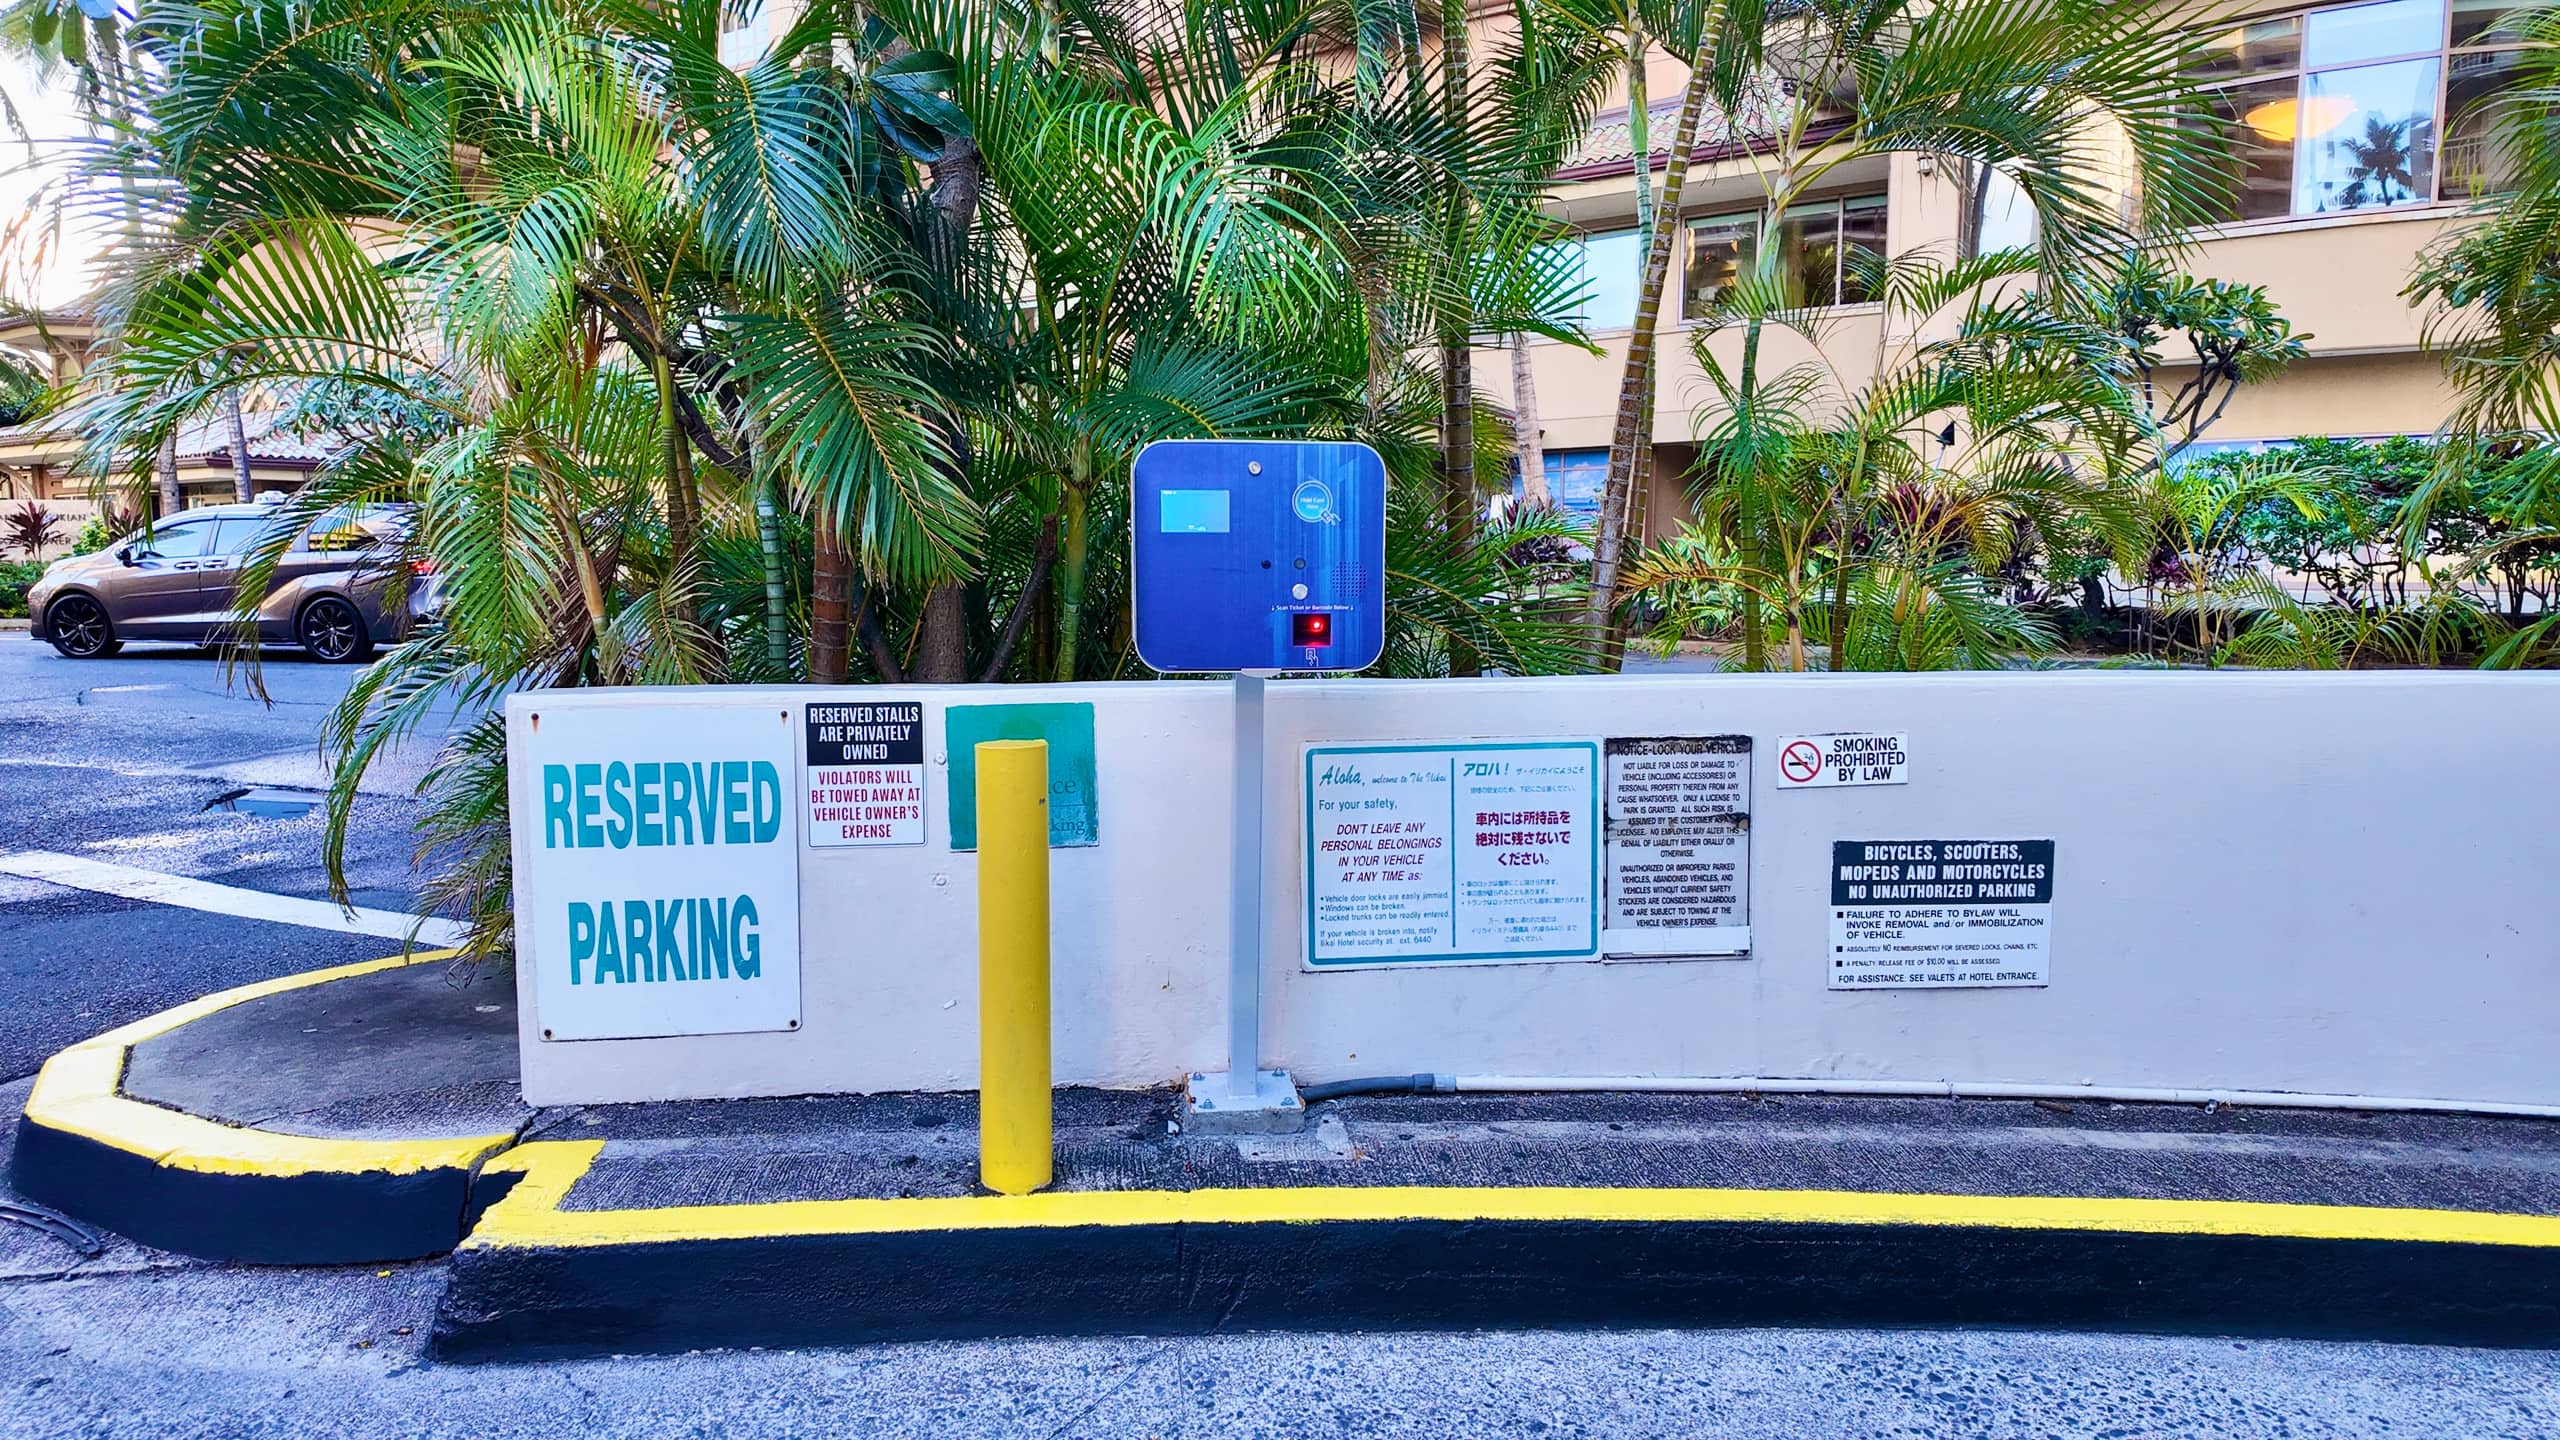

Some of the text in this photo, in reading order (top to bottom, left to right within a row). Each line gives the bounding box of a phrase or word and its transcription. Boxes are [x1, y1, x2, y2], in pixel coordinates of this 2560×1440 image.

[810, 707, 918, 723] RESERVED STALLS
[819, 725, 910, 742] ARE PRIVATELY
[1834, 737, 1898, 752] SMOKING
[843, 744, 887, 760] OWNED
[1673, 761, 1688, 769] LOSS
[1825, 752, 1905, 767] PROHIBITED
[819, 770, 912, 785] VIOLATORS WILL
[1319, 764, 1365, 786] Aloha,
[1372, 774, 1398, 783] welcome
[1401, 775, 1407, 783] to
[1622, 773, 1646, 781] VEHICLE
[1839, 766, 1892, 781] BY LAW
[1618, 784, 1648, 792] PERSONAL
[812, 788, 920, 803] BE TOWED AWAY AT
[544, 761, 781, 849] RESERVED
[1319, 800, 1334, 810] For
[1339, 800, 1360, 812] your
[814, 806, 918, 821] VEHICLE OWNER'S
[1476, 810, 1570, 825] 車内には所持品を
[843, 824, 891, 838] EXPENSE
[1337, 822, 1426, 835] DON'T LEAVE ANY
[1321, 837, 1442, 851] PERSONAL BELONGINGS
[1476, 831, 1571, 846] 絶対に残さないで
[1498, 852, 1549, 866] ください。
[1865, 844, 2022, 862] BICYCLES, SCOOTERS,
[1338, 854, 1424, 867] IN YOUR VEHICLE
[1342, 872, 1354, 882] AT
[1357, 871, 1378, 882] ANY
[1382, 871, 1404, 881] TIME
[1841, 864, 2045, 880] MOPEDS AND MOTORCYCLES
[1653, 886, 1678, 894] WITHOUT
[1710, 885, 1731, 893] SAFETY
[1849, 883, 2035, 899] NO UNAUTHORIZED PARKING
[1325, 904, 1354, 912] Windows
[1847, 910, 1885, 919] FAILURE
[1889, 910, 1900, 918] TO
[1905, 910, 1943, 918] ADHERE
[1963, 909, 1995, 917] BYLAW
[1636, 919, 1659, 927] VEHICLE
[1847, 921, 1881, 929] INVOKE
[1886, 920, 1929, 928] REMOVAL
[1969, 919, 2044, 927] IMMOBILIZATION
[568, 895, 760, 985] PARKING
[1847, 931, 1905, 939] OF VEHICLE.
[1883, 944, 1891, 952] NO
[1839, 975, 1854, 983] FOR
[1909, 974, 1924, 982] SEE
[1928, 973, 1955, 981] VALETS
